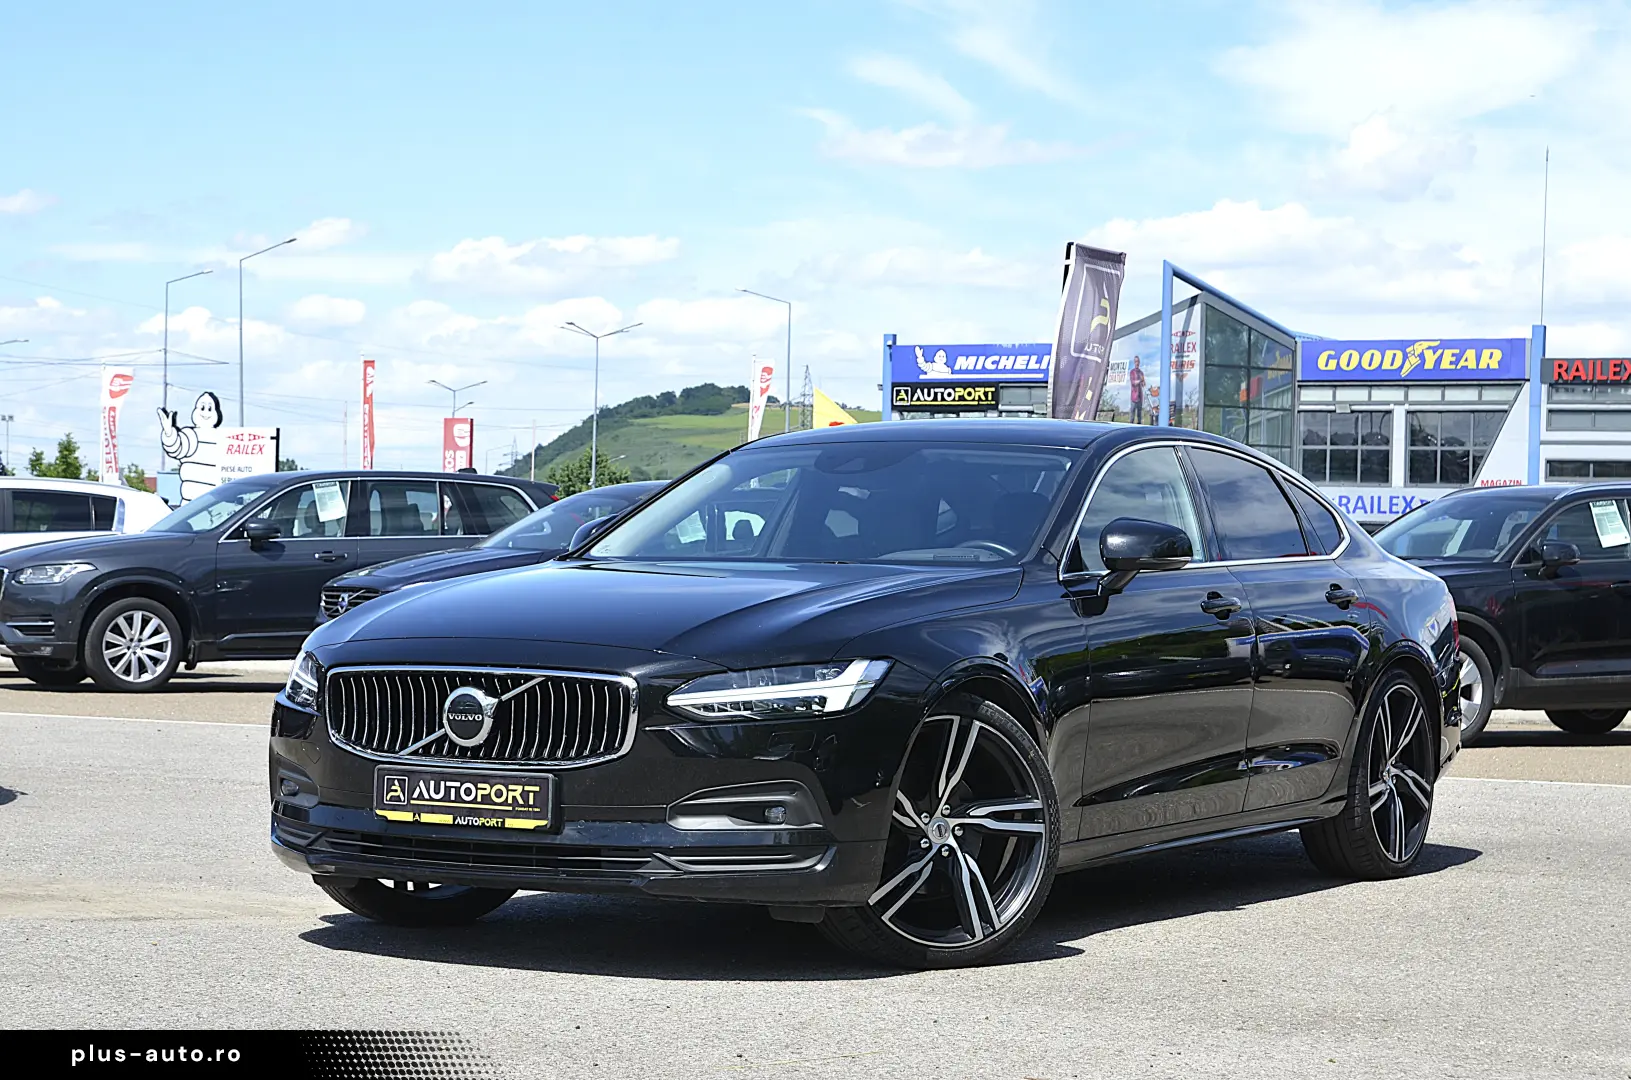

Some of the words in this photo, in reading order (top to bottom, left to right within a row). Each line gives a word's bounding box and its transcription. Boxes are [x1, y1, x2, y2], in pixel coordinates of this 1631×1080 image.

[953, 355, 1051, 371] MICHELI
[1553, 360, 1631, 381] RAILEX
[912, 387, 995, 402] AUTOPORT
[226, 443, 266, 455] RAILEX
[1338, 495, 1416, 514] RAILEX
[448, 712, 483, 721] VOLVO
[412, 779, 540, 805] AUTOPORT
[454, 815, 503, 828] AUTOPORT
